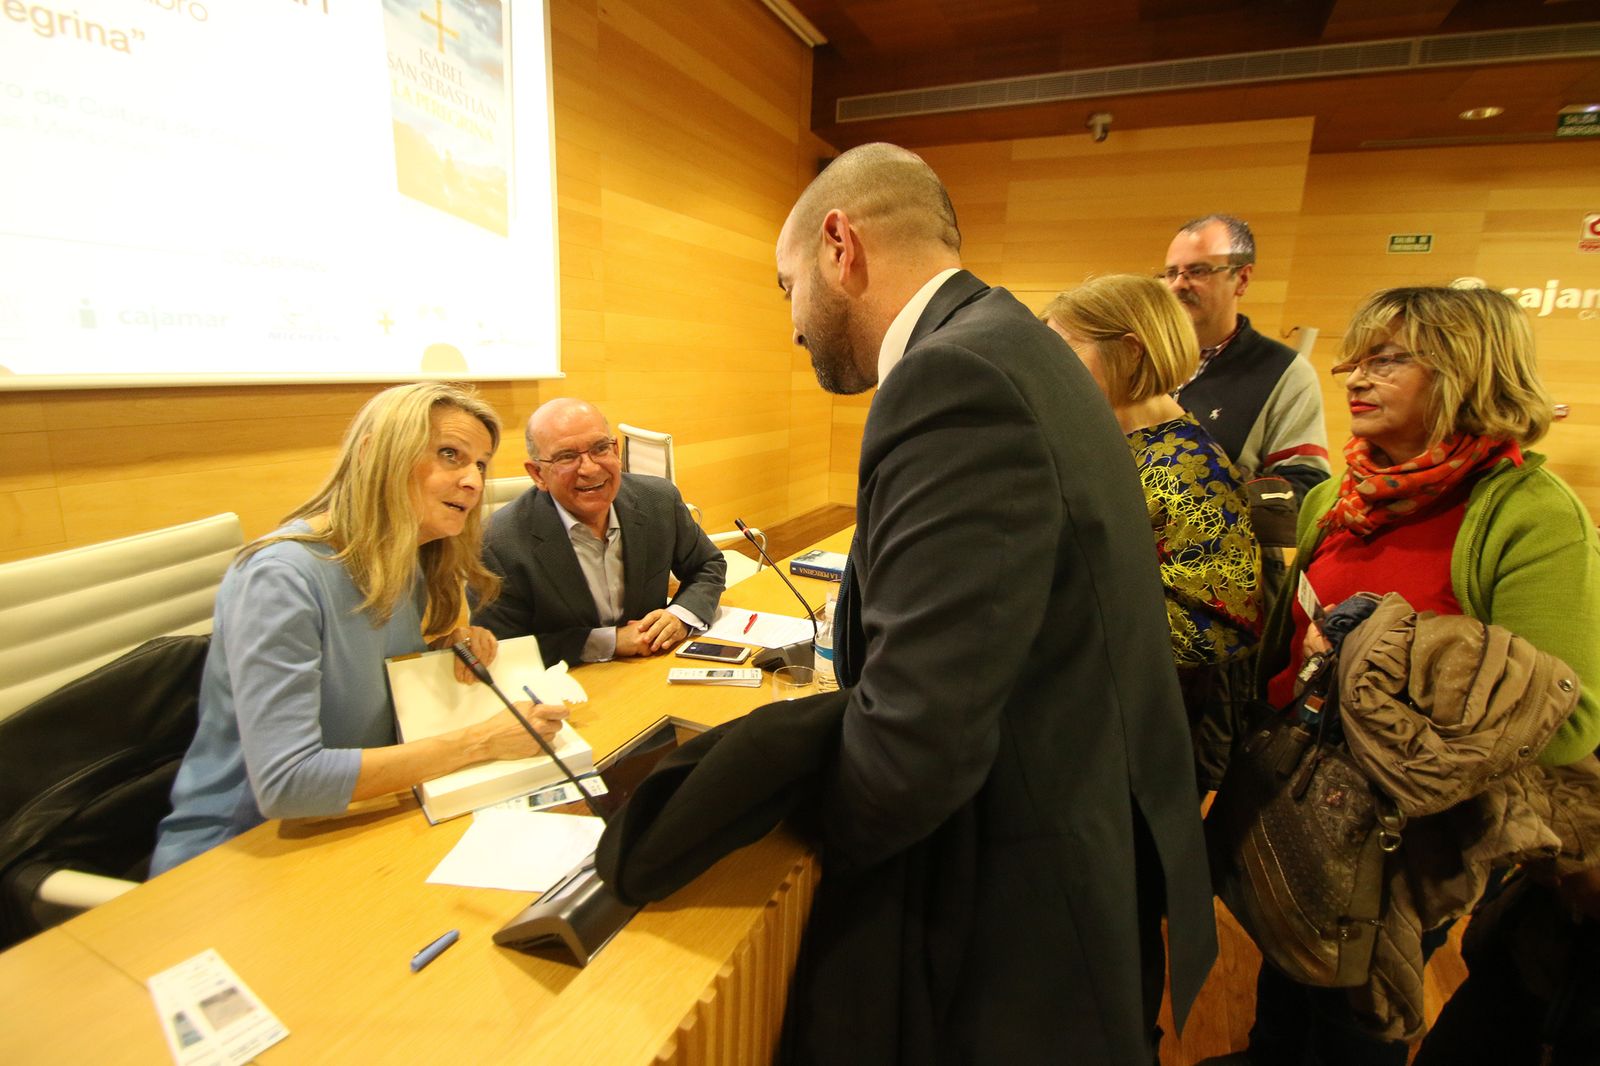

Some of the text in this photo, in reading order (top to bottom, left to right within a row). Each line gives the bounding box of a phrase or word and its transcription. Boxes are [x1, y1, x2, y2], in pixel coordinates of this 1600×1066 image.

[386, 51, 418, 82] SAN
[418, 48, 465, 88] ISABEL
[117, 304, 231, 333] cajamar
